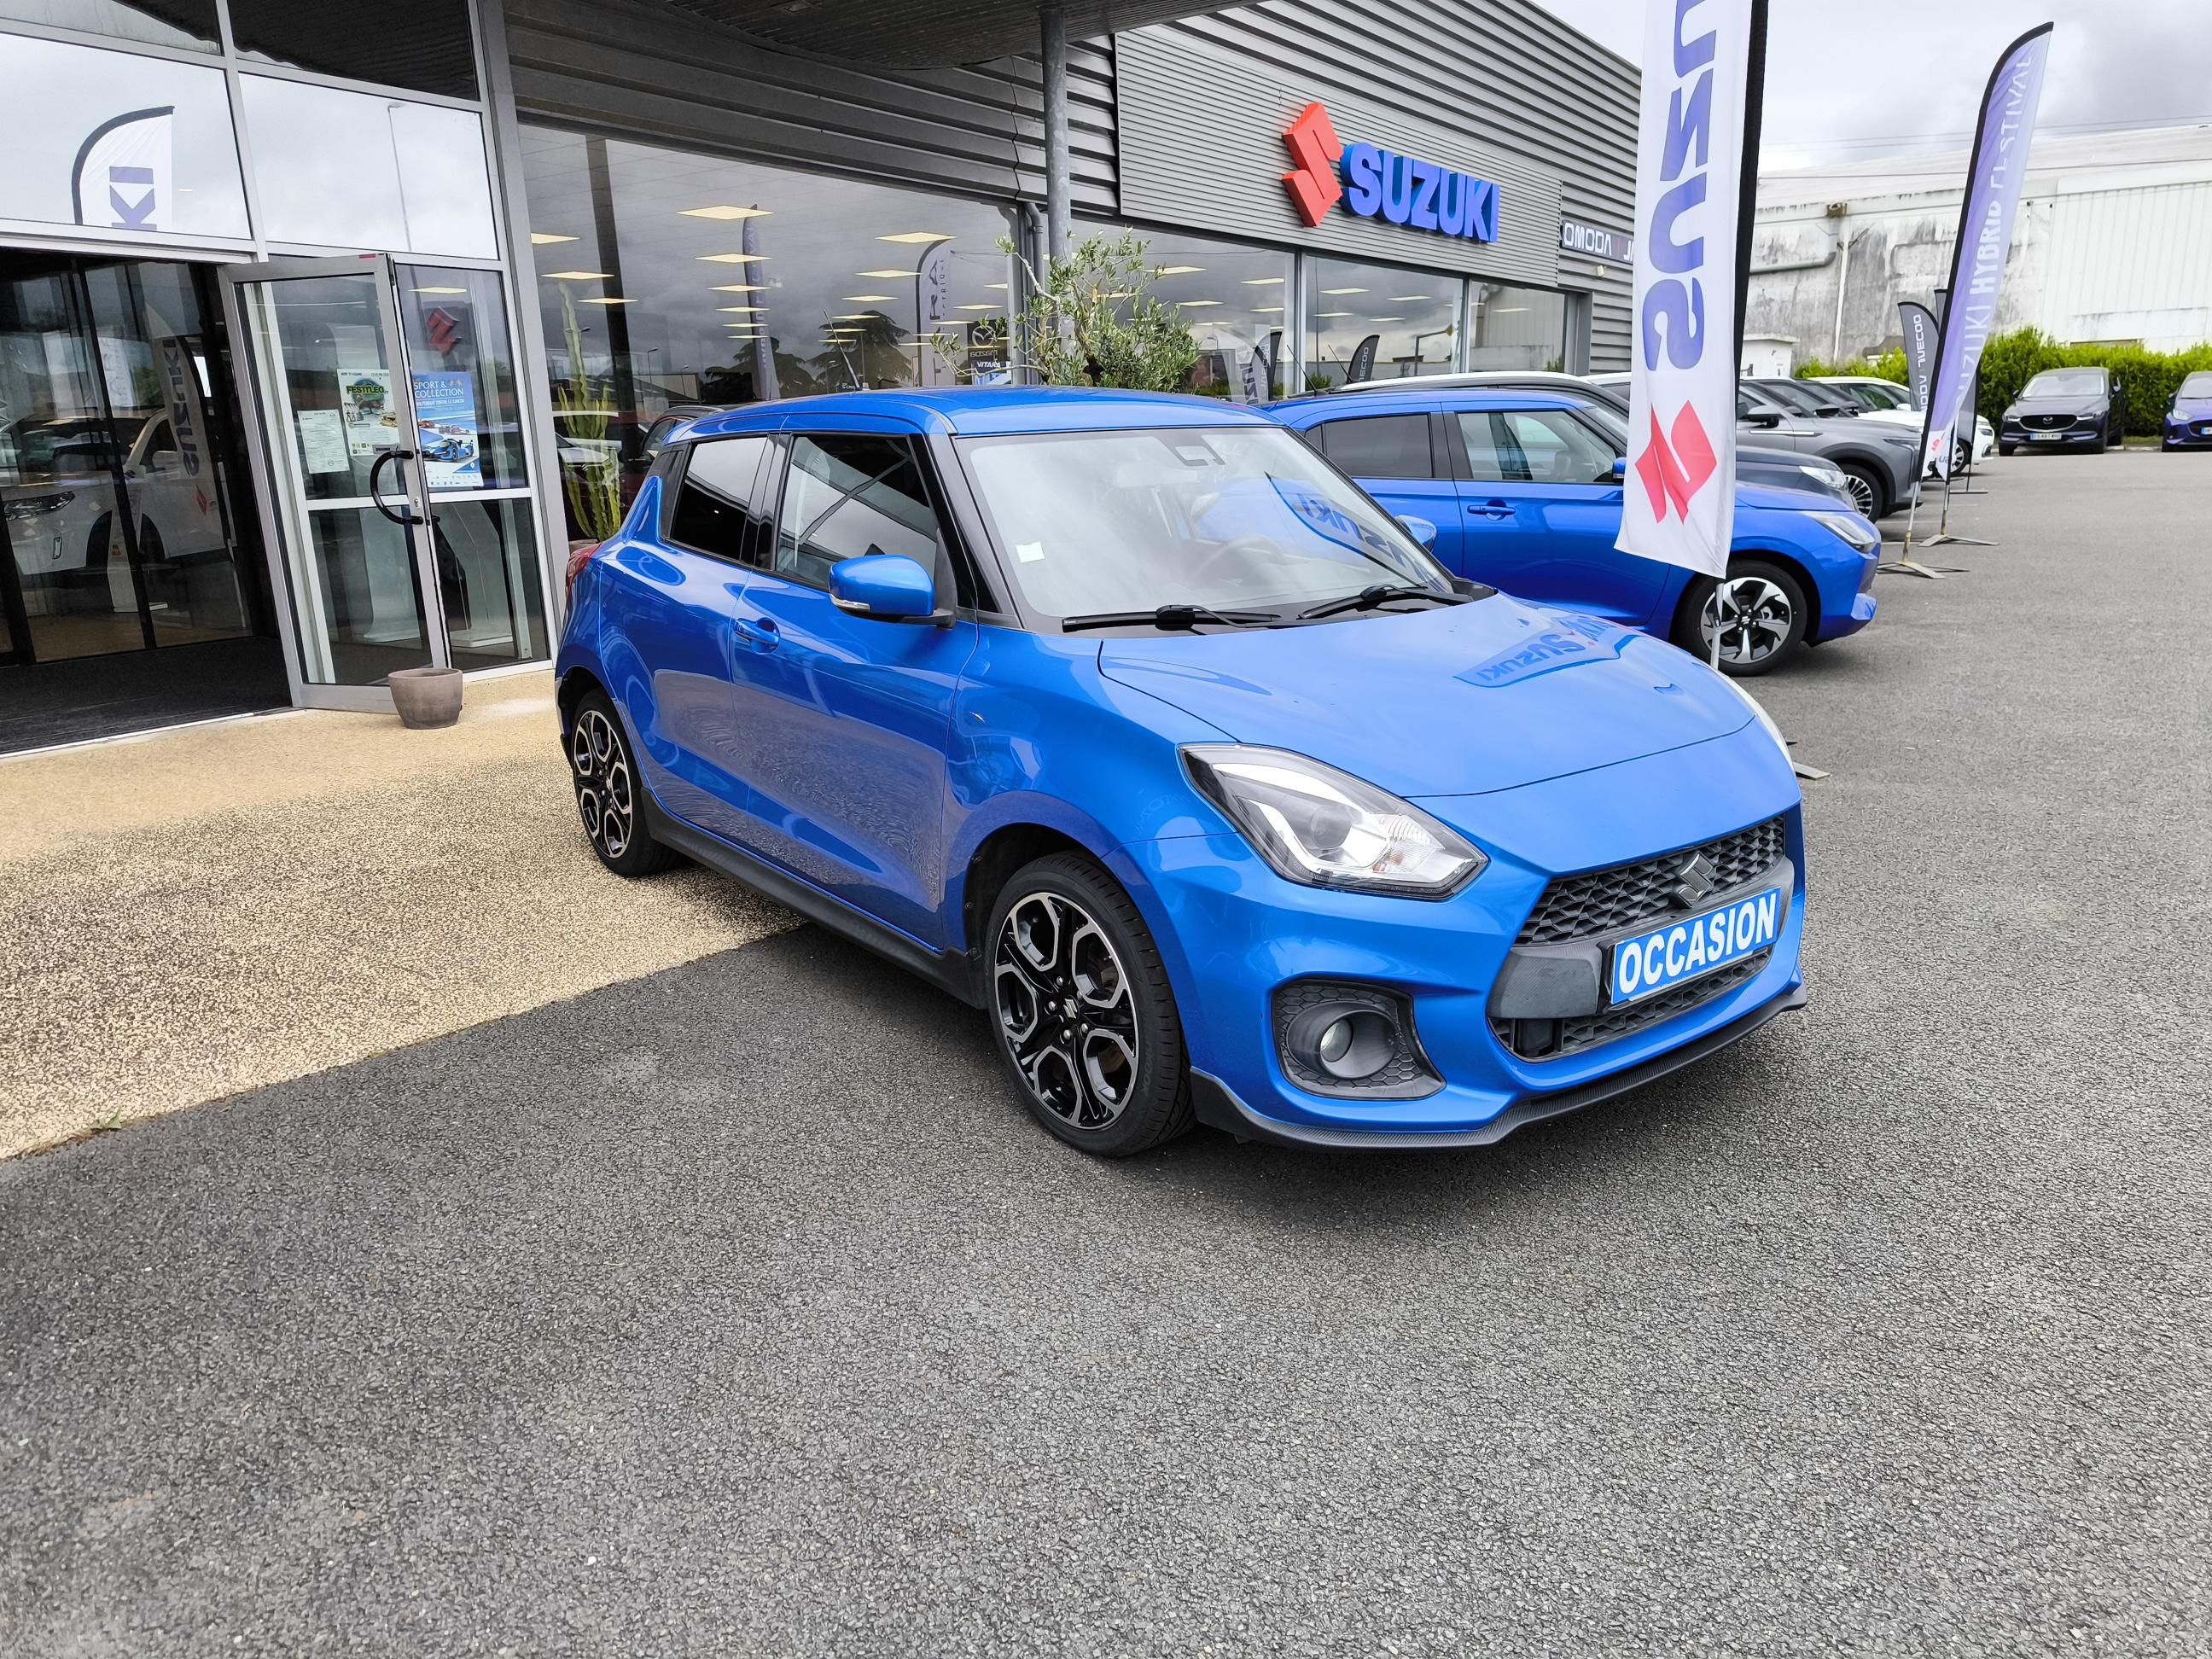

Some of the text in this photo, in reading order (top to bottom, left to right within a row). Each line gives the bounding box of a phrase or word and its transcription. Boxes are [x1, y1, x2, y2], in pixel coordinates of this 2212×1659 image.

[1340, 142, 1501, 243] SUZUKI
[1969, 200, 2002, 294] HYBRID
[1990, 56, 2032, 189] FESTIVAL
[1563, 222, 1612, 256] OMODA
[413, 381, 439, 390] SPORT
[415, 388, 463, 399] COLLECTION
[1618, 893, 1777, 995] OCCASION
